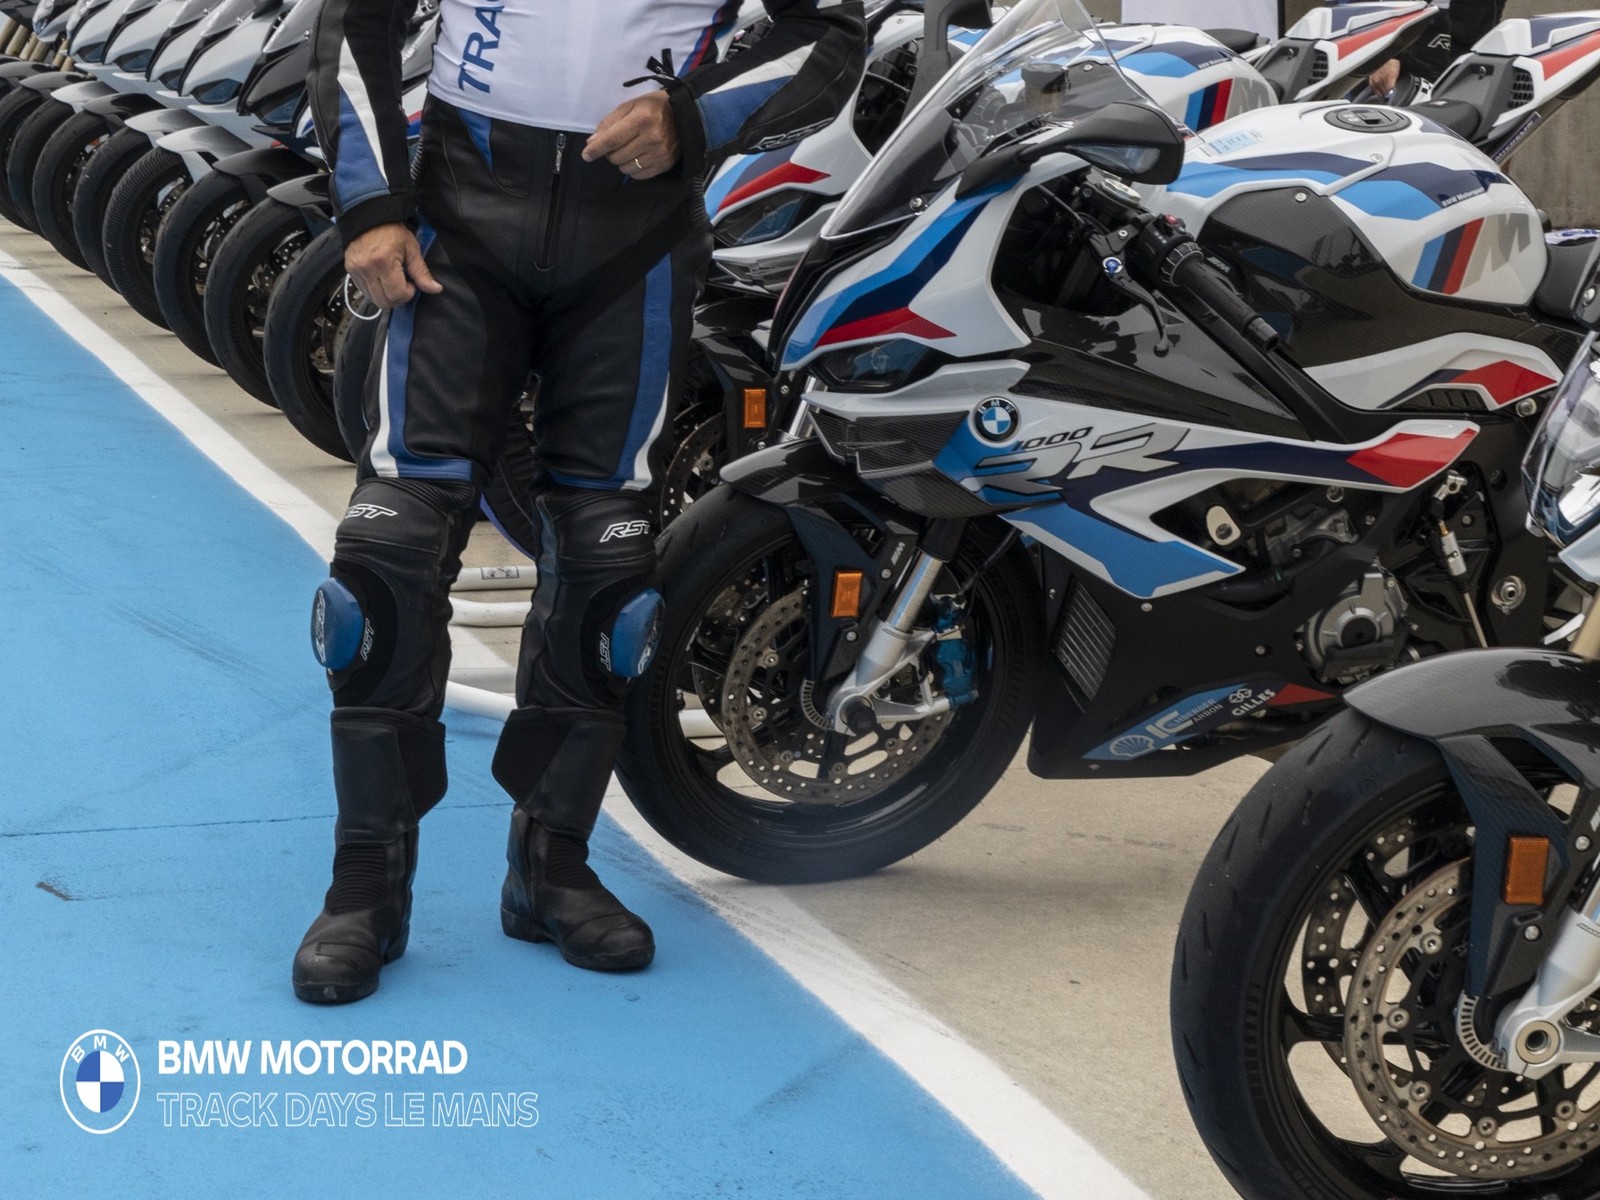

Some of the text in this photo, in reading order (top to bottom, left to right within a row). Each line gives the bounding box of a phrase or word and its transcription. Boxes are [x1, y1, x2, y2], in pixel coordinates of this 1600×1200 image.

[360, 617, 375, 661] RST
[600, 632, 612, 672] RST
[1231, 688, 1276, 716] GILLES
